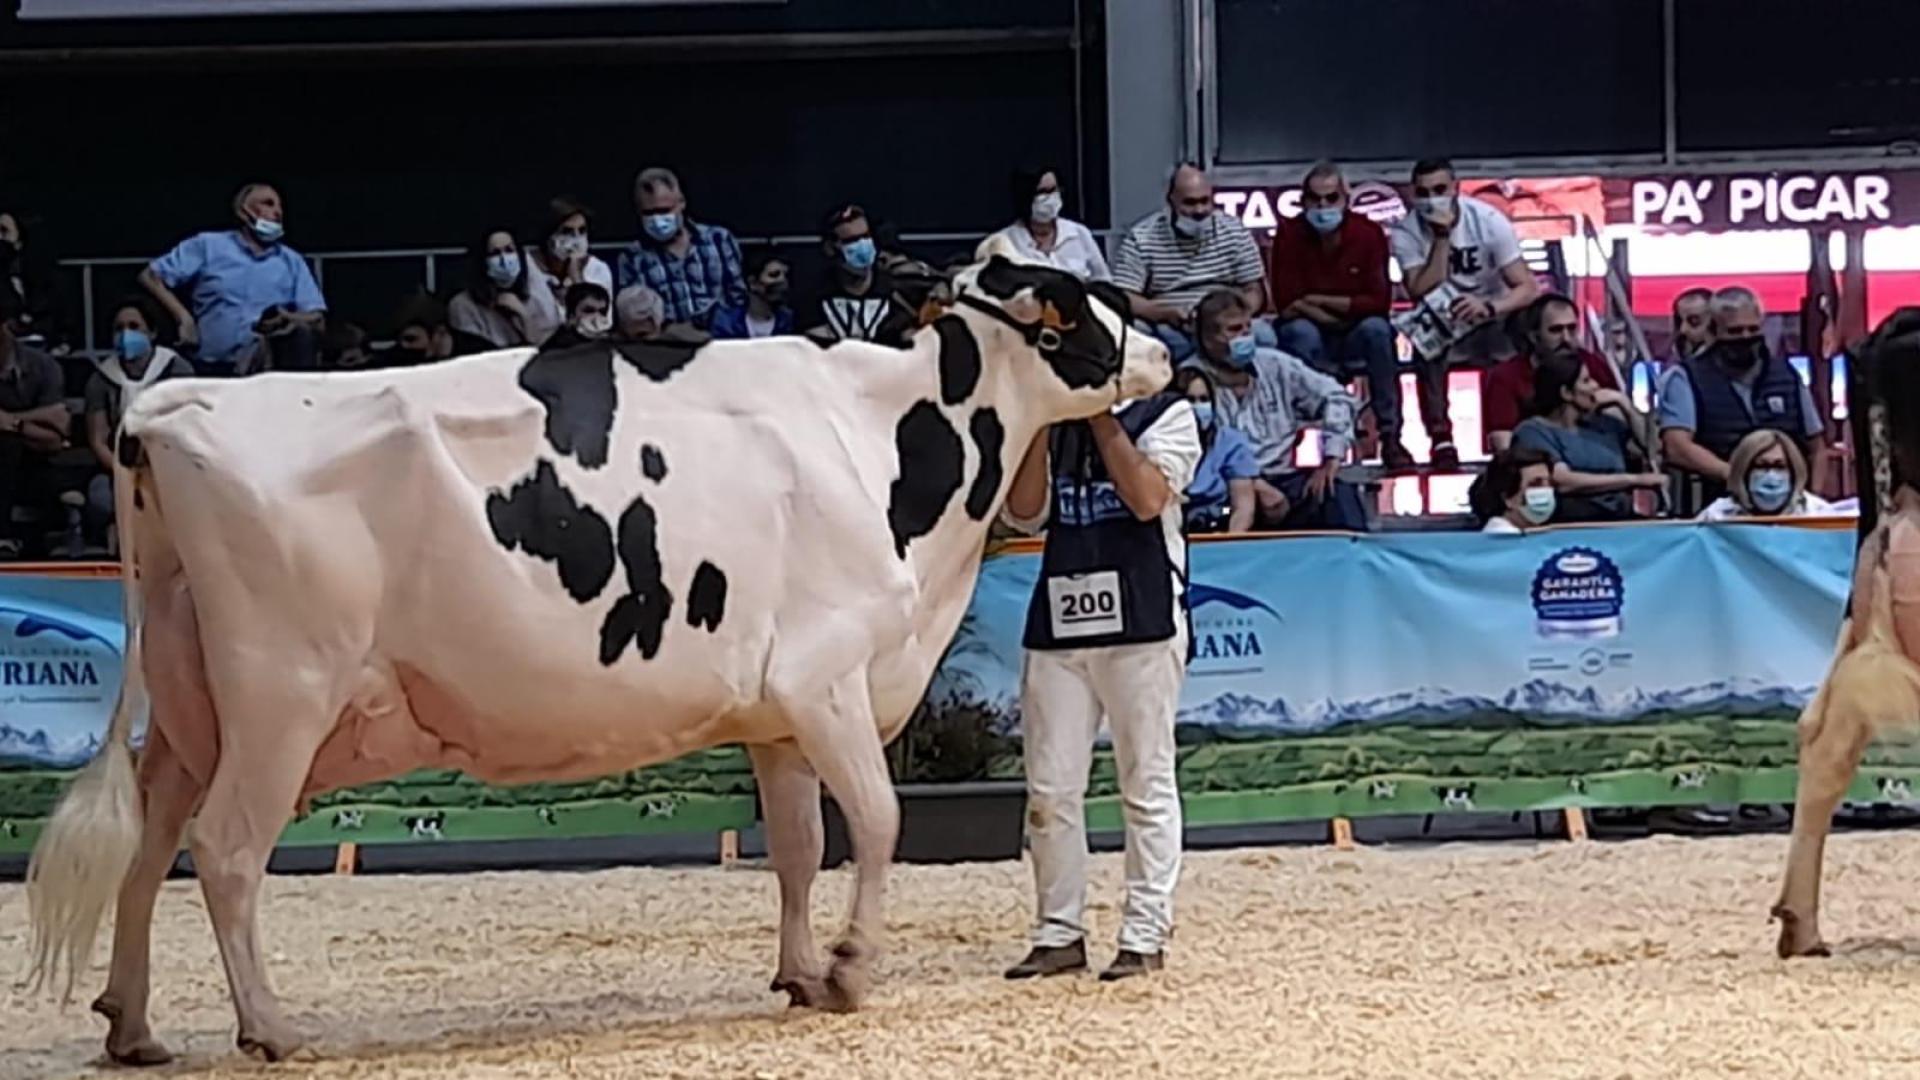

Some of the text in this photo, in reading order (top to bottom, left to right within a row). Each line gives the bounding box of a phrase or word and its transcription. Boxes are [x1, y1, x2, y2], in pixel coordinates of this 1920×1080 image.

[1729, 174, 1891, 223] PICAR
[1060, 590, 1115, 617] 200
[1539, 587, 1616, 601] GANADERA
[0, 660, 99, 686] RIANA
